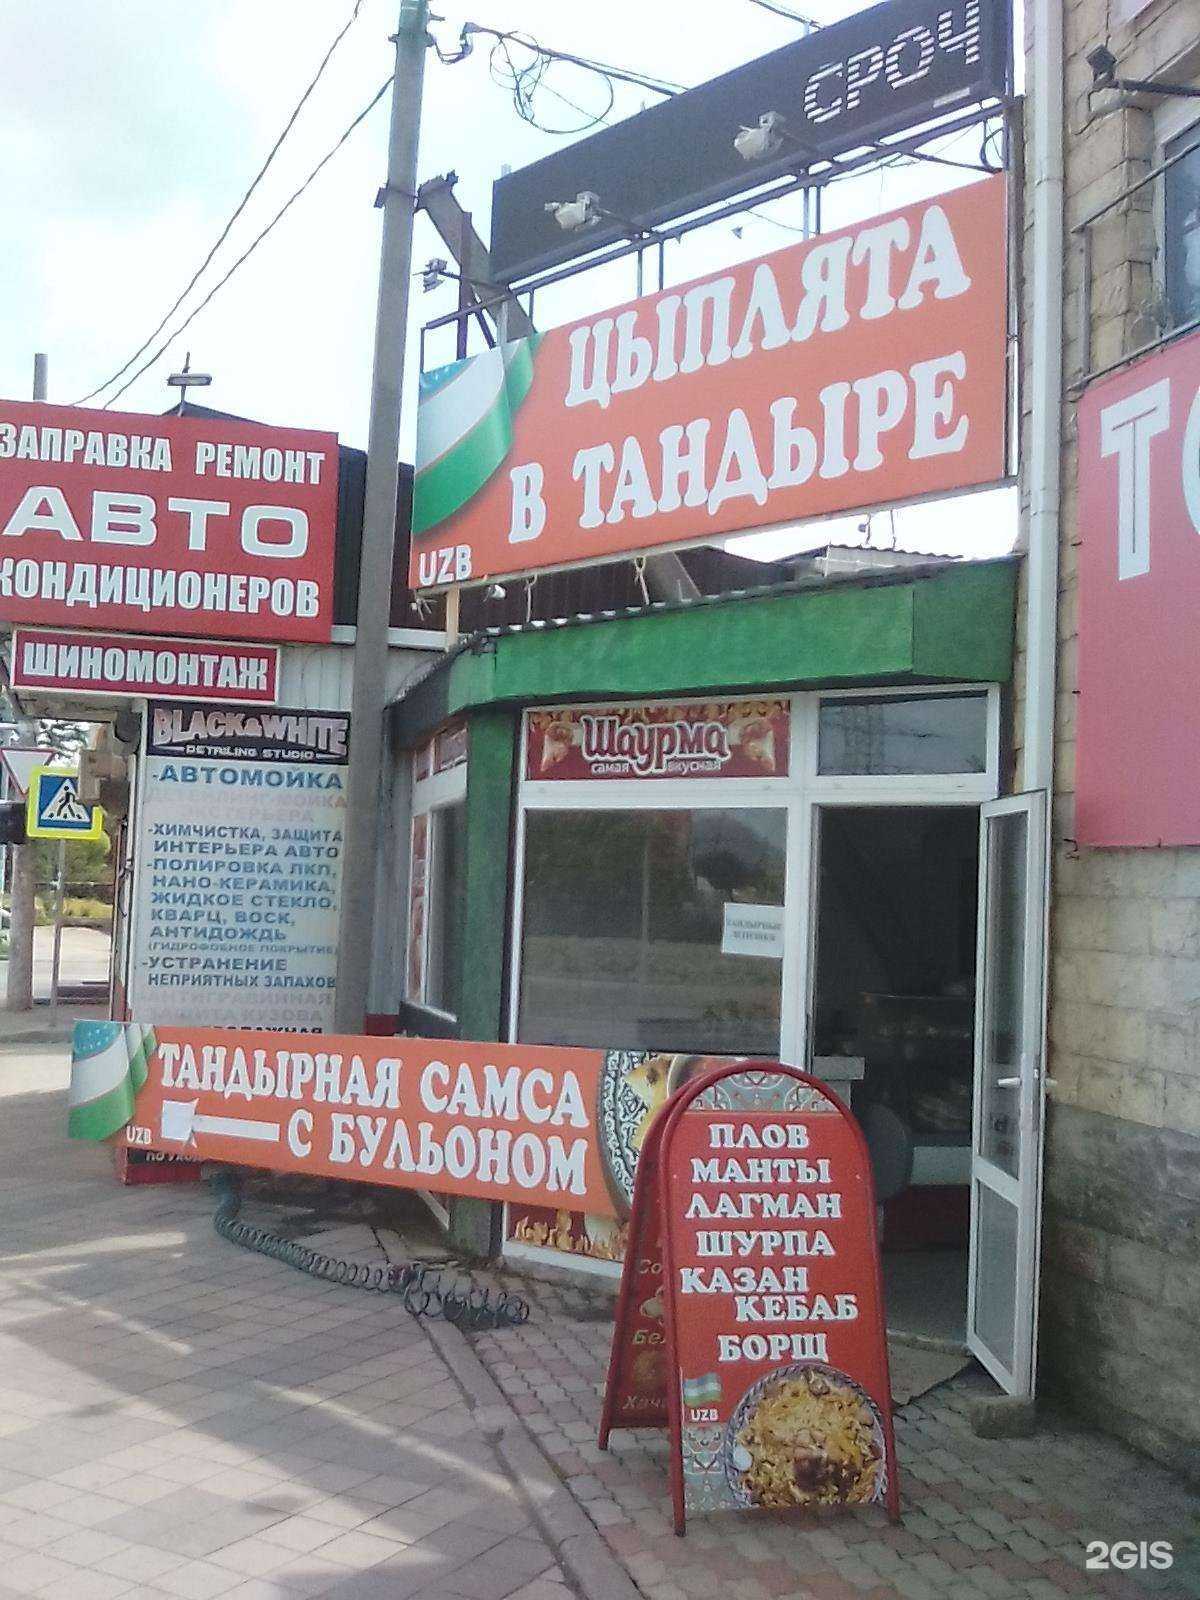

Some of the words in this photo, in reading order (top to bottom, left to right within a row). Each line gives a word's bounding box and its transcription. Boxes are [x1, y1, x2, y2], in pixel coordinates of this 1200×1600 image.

[565, 205, 971, 408] ЦЫПЛЯТА
[0, 423, 172, 472] ЗАПРАВКА
[195, 441, 325, 485] РЕМОНТ
[508, 462, 547, 543] В
[572, 351, 969, 528] ТАНДЫРЕ
[2, 485, 309, 558] АВТО
[418, 545, 472, 587] UZB
[0, 557, 320, 618] КОНДИЦИОНЕРОВ
[22, 642, 269, 690] ШИНОМОНТАЖ
[262, 748, 315, 760] STUDIO
[580, 715, 731, 775] Шаурма
[591, 763, 629, 774] самая
[154, 840, 278, 857] ИНТЕРЬЕРА
[284, 846, 339, 858] АВТО
[272, 829, 343, 842] ЗАЩИТА
[151, 892, 243, 907] ЖИДКОЕ
[250, 896, 337, 912] СТЕКЛО,
[150, 926, 287, 942] АНТИДОЖДЬ
[148, 973, 258, 987] НЕПРИЯТНЫХ
[264, 976, 336, 988] ЗАПАХОВ
[158, 1043, 402, 1108] ТАНДЫРНАЯ
[419, 1061, 589, 1128] САМСА
[708, 1123, 809, 1150] ПЛОВ
[288, 1110, 314, 1158] С
[329, 1114, 588, 1196] БУЛЬОНОМ
[690, 1158, 831, 1185] МАНТЫ
[685, 1193, 842, 1220] ЛАГМАН
[696, 1230, 835, 1257] ШУРПА
[680, 1267, 809, 1294] КАЗАН
[735, 1294, 859, 1322] КЕБАБ
[717, 1333, 829, 1363] БОРЩ
[690, 1409, 719, 1423] UZB
